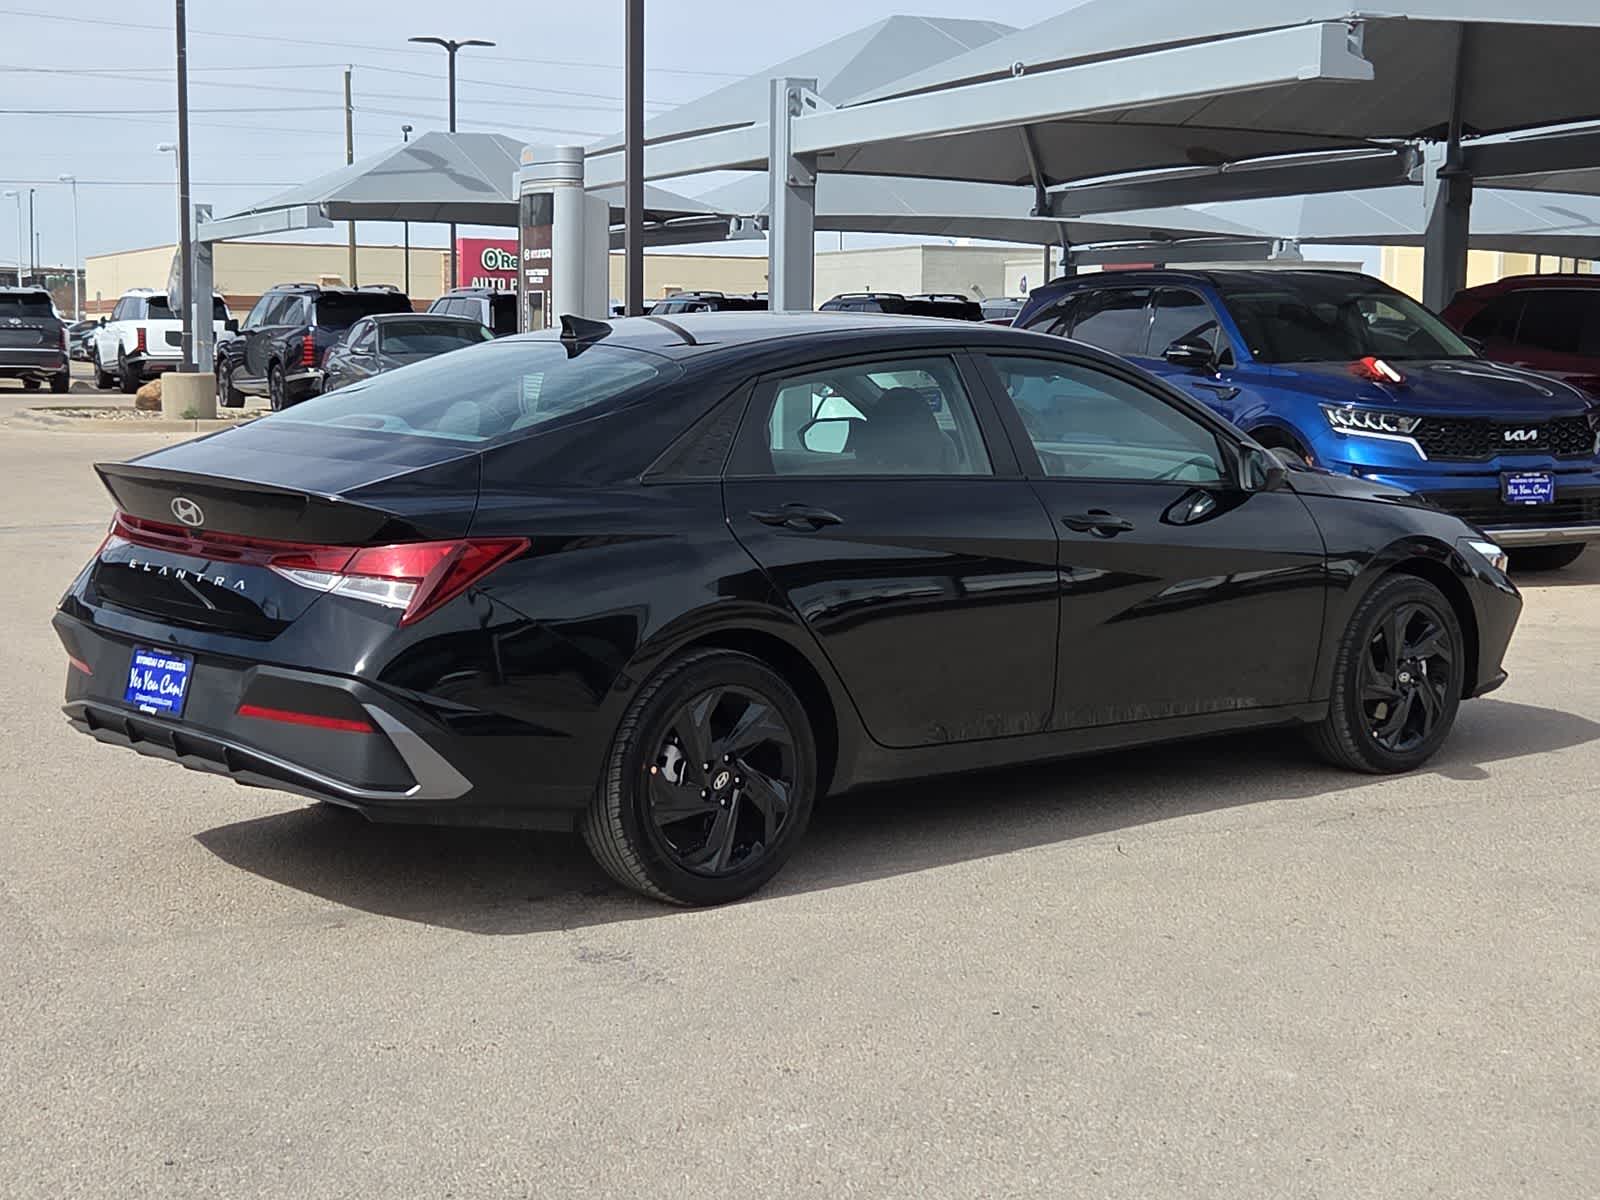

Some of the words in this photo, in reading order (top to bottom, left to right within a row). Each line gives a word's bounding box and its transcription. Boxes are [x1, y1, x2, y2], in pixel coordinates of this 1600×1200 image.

[471, 277, 506, 290] AUTO
[1504, 429, 1537, 441] KIA
[128, 558, 246, 590] ELANTRA
[129, 667, 142, 690] Yes
[142, 670, 159, 692] You
[160, 673, 187, 698] Can!
